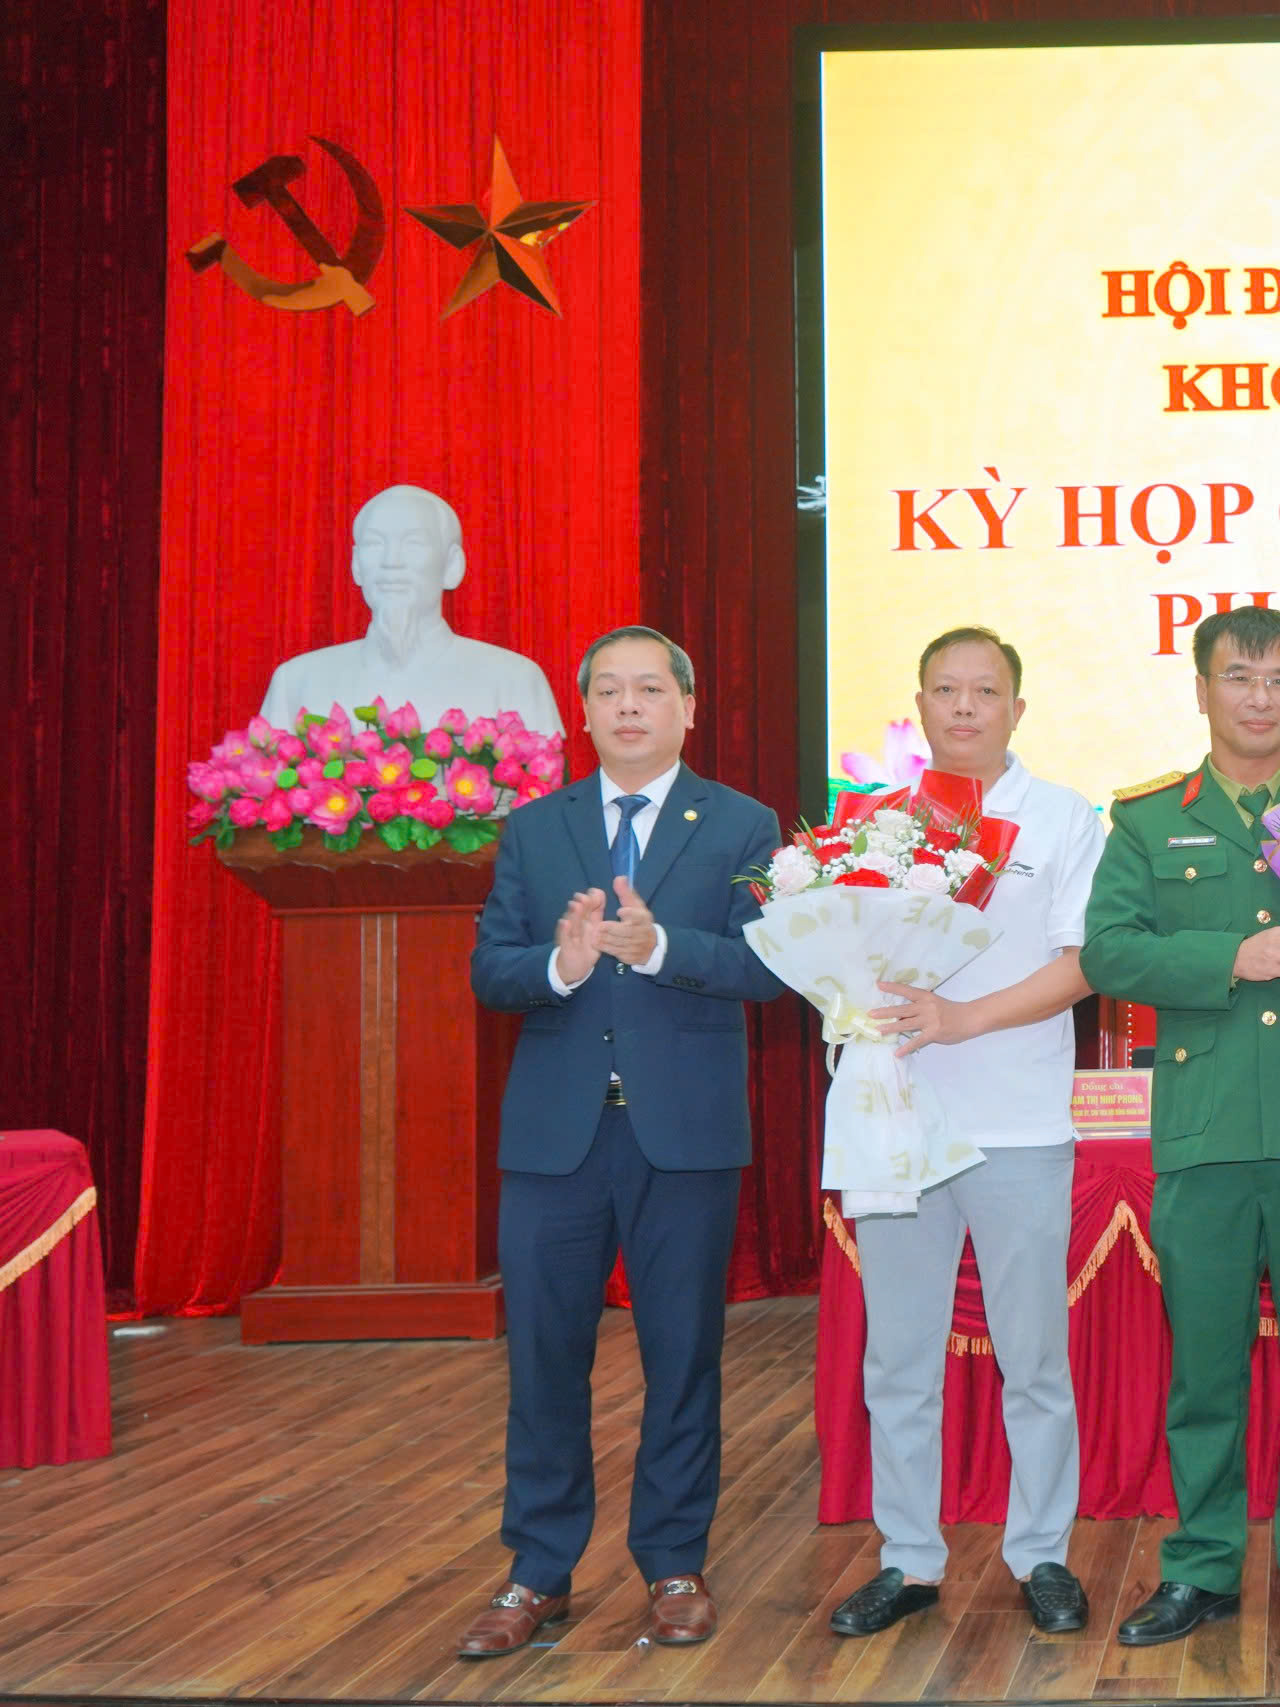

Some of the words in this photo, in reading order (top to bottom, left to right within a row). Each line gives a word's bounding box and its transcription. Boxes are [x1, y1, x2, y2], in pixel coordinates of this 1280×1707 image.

[1102, 261, 1231, 329] HỘI
[891, 466, 1027, 551] KỲ
[1055, 483, 1254, 564] HỌP
